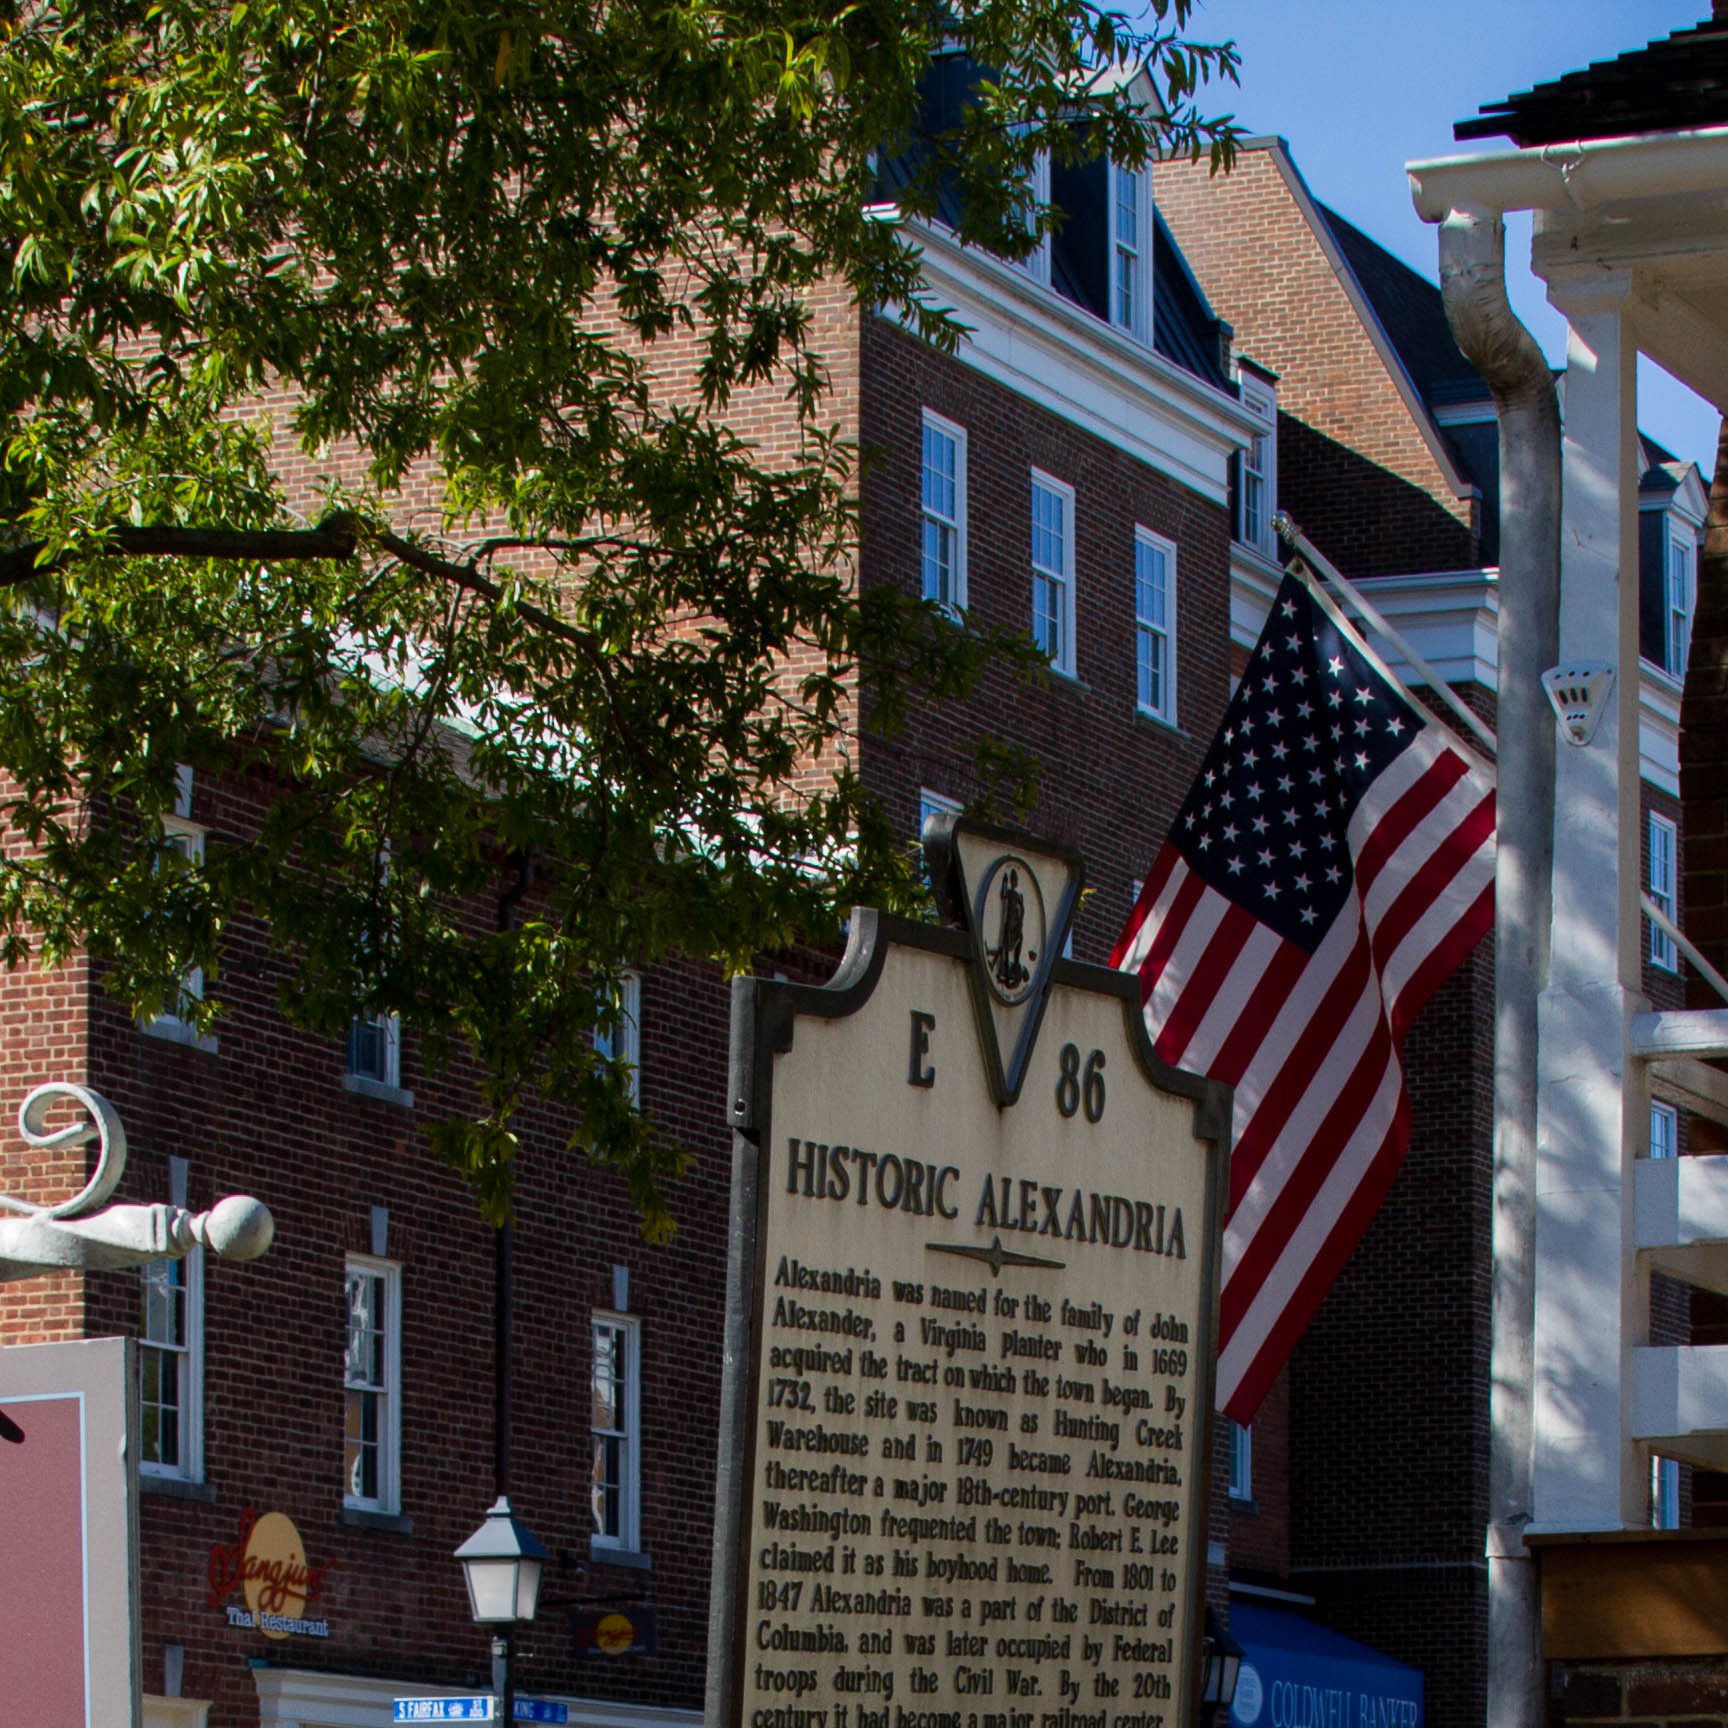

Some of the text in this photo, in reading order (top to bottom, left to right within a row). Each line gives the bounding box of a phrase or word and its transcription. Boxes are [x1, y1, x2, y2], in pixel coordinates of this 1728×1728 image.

[907, 1009, 1106, 1123] E 86
[786, 1137, 1187, 1259] HISTORIC ALEXANDRIA
[773, 1254, 1188, 1344] Alexandria was named for the family of John
[771, 1295, 1187, 1378] Alexander, a Virginia planter who in 1669
[768, 1342, 1186, 1421] acquired the tract on which the town began. By
[766, 1376, 1183, 1451] 1732, the site was known as Hunting Creek
[765, 1419, 1182, 1487] Warehouse and in 1749 became Alexandria,
[761, 1499, 1178, 1555] Washington frequented the town; Robert E. Lee
[757, 1540, 1176, 1592] claimed it as his boyhood home. From 1801 to
[226, 1606, 329, 1637] Thai Restaurant
[756, 1578, 1176, 1629] 1847 Alexandria was a part of the District of
[755, 1618, 1173, 1667] Columbia, and was later occupied by Federal
[399, 1700, 445, 1718] S FAIRFAX
[514, 1700, 535, 1718] KING
[753, 1661, 1171, 1706] troops during the Civil War. By the 20th
